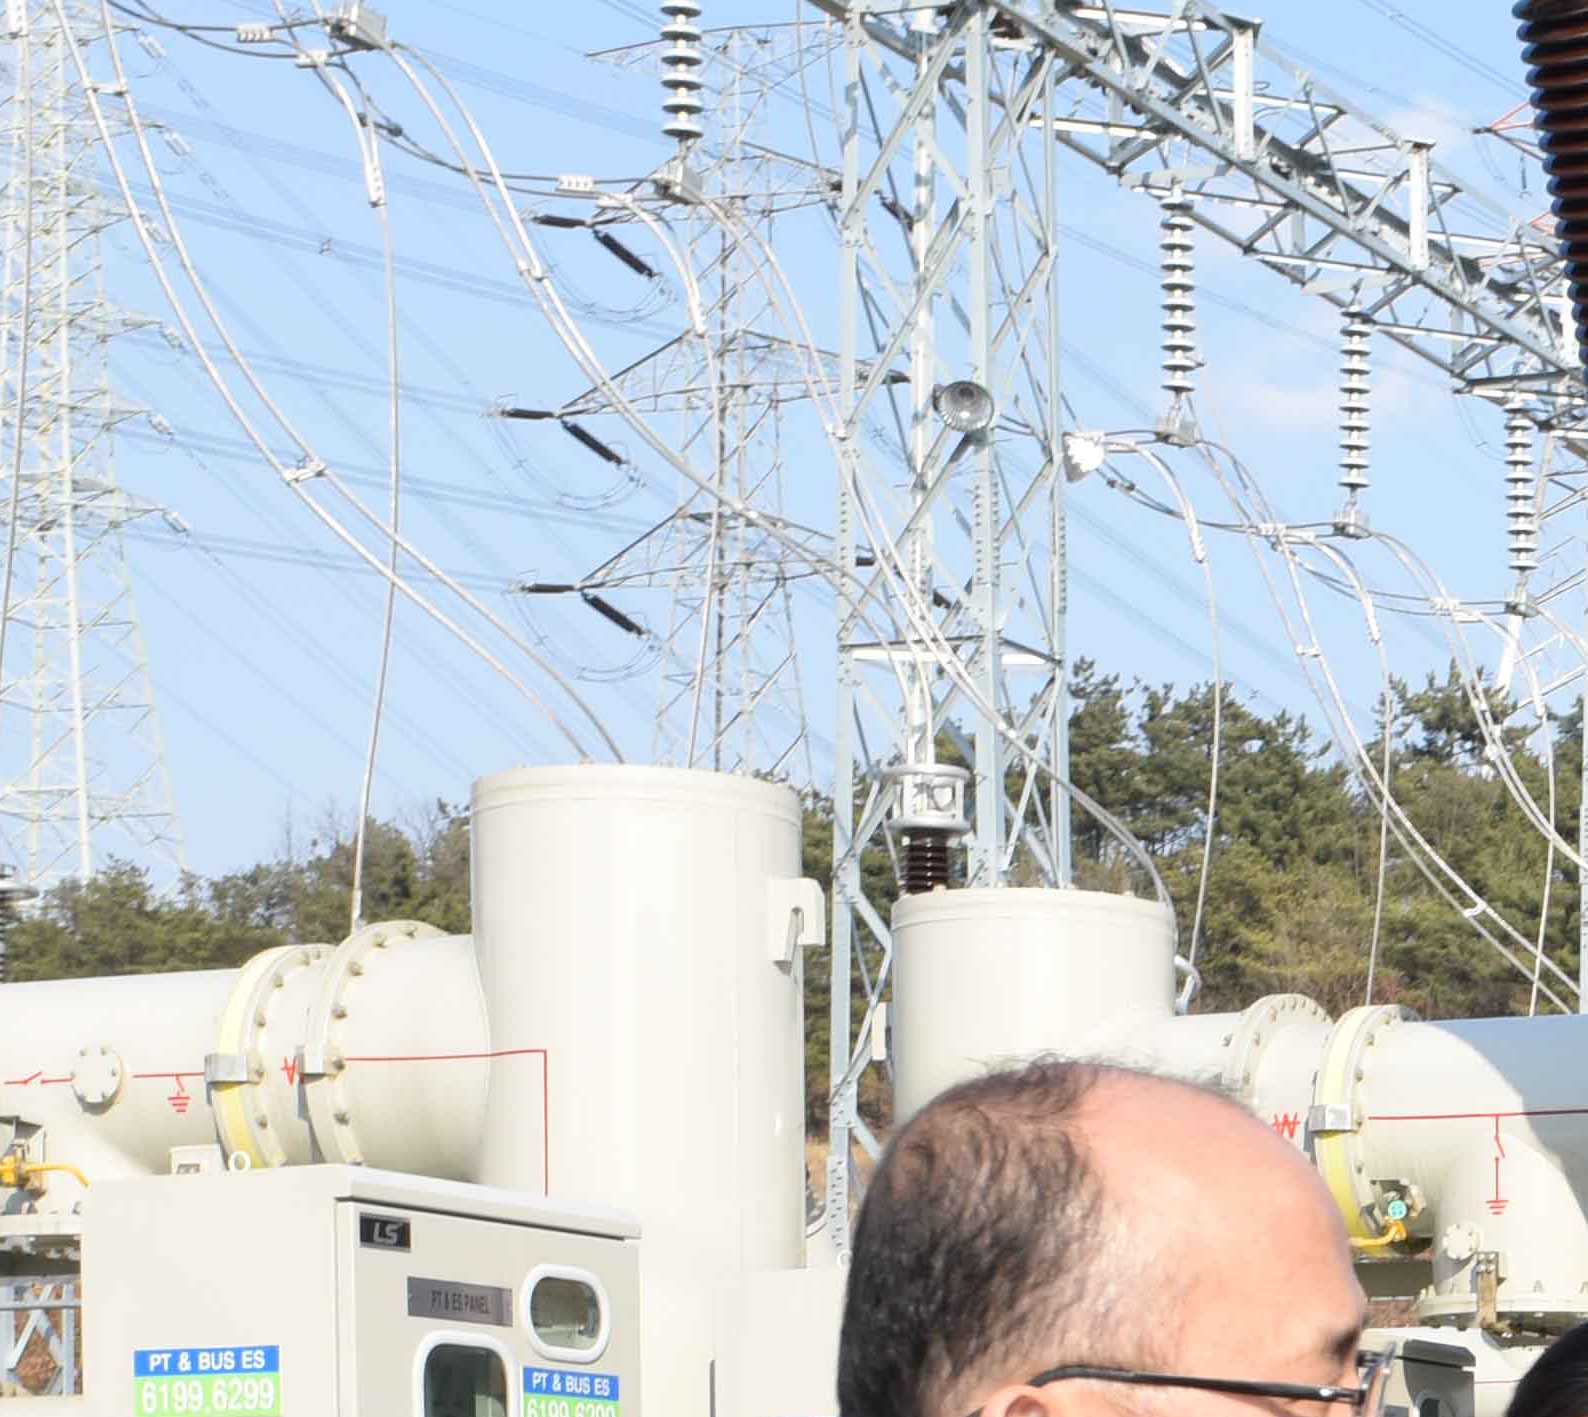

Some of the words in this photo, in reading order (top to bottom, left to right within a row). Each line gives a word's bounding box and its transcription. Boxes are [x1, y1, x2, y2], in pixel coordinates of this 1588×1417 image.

[373, 1222, 401, 1244] LS
[149, 1353, 172, 1372] PT
[178, 1351, 192, 1372] &
[198, 1351, 236, 1371] BUS
[241, 1350, 266, 1369] ES
[532, 1371, 548, 1390] PT
[552, 1373, 562, 1391] &
[565, 1375, 591, 1394] BUS
[593, 1377, 611, 1397] ES
